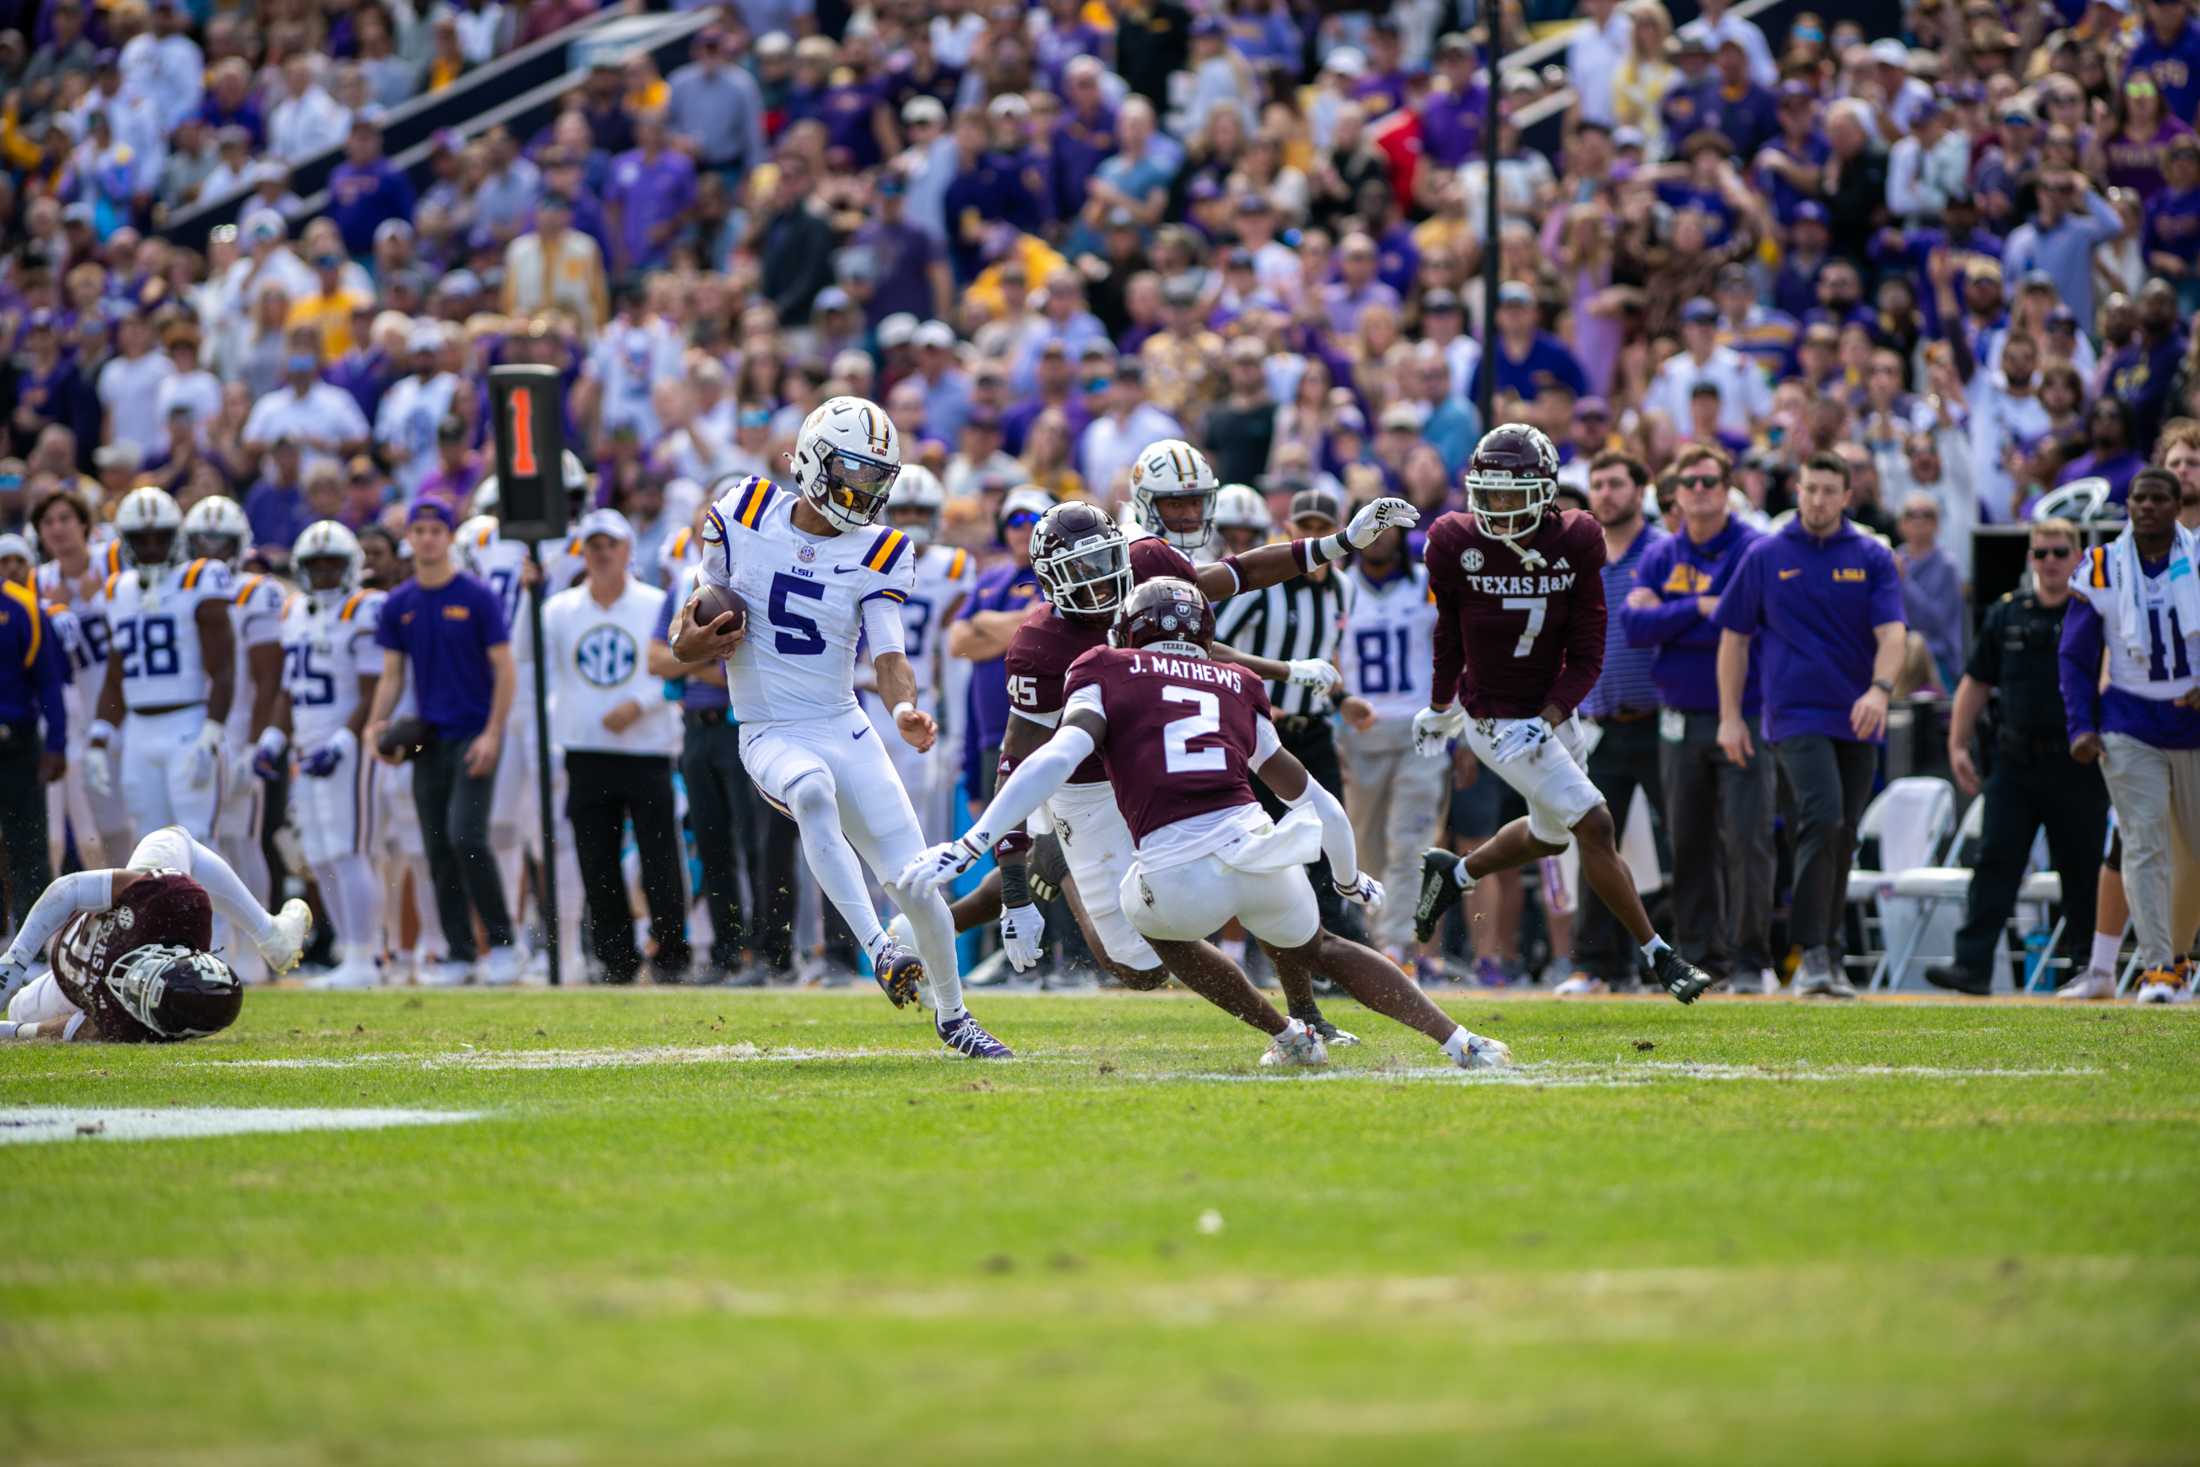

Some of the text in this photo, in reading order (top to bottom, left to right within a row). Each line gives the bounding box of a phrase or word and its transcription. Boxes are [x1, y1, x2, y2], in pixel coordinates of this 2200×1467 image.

[509, 387, 538, 477] 1
[792, 566, 814, 577] LSU
[1466, 575, 1534, 595] TEXAS
[1833, 568, 1866, 582] LSU
[768, 571, 826, 655] 5
[1502, 597, 1547, 658] 7
[112, 617, 180, 677] 28
[1162, 642, 1184, 651] TEXAS
[1356, 627, 1413, 694] 81
[2147, 606, 2192, 682] 11
[1007, 674, 1038, 706] 45
[1129, 655, 1242, 694] J. MATHEWS
[1162, 685, 1228, 773] 2
